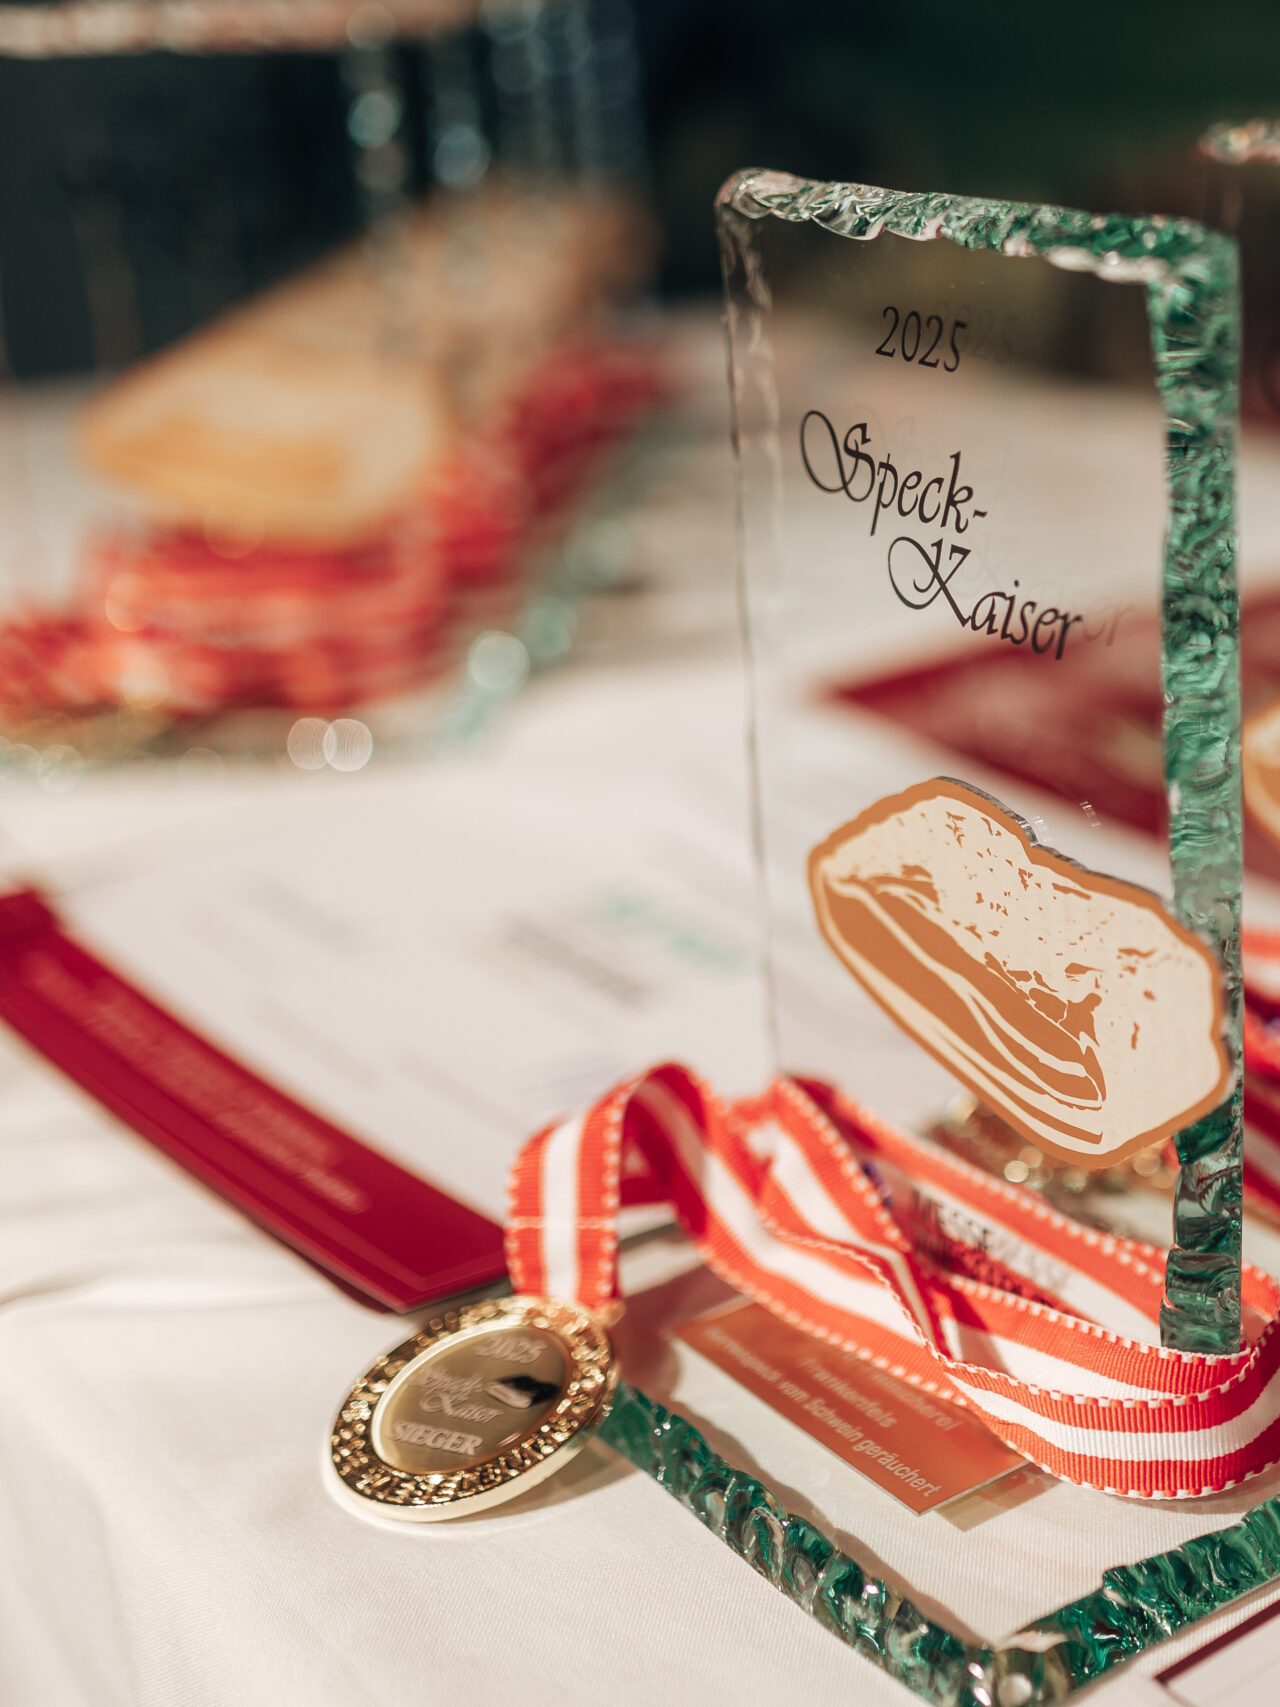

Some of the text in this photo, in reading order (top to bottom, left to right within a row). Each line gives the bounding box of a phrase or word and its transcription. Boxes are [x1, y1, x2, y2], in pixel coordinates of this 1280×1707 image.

[875, 305, 968, 372] 2025
[800, 410, 988, 536] Speck-
[887, 536, 1083, 660] Kaiser
[389, 1420, 484, 1456] SIEGER
[779, 1380, 810, 1402] vom
[803, 1397, 865, 1443] Schwein
[853, 1436, 943, 1499] geräuchert
